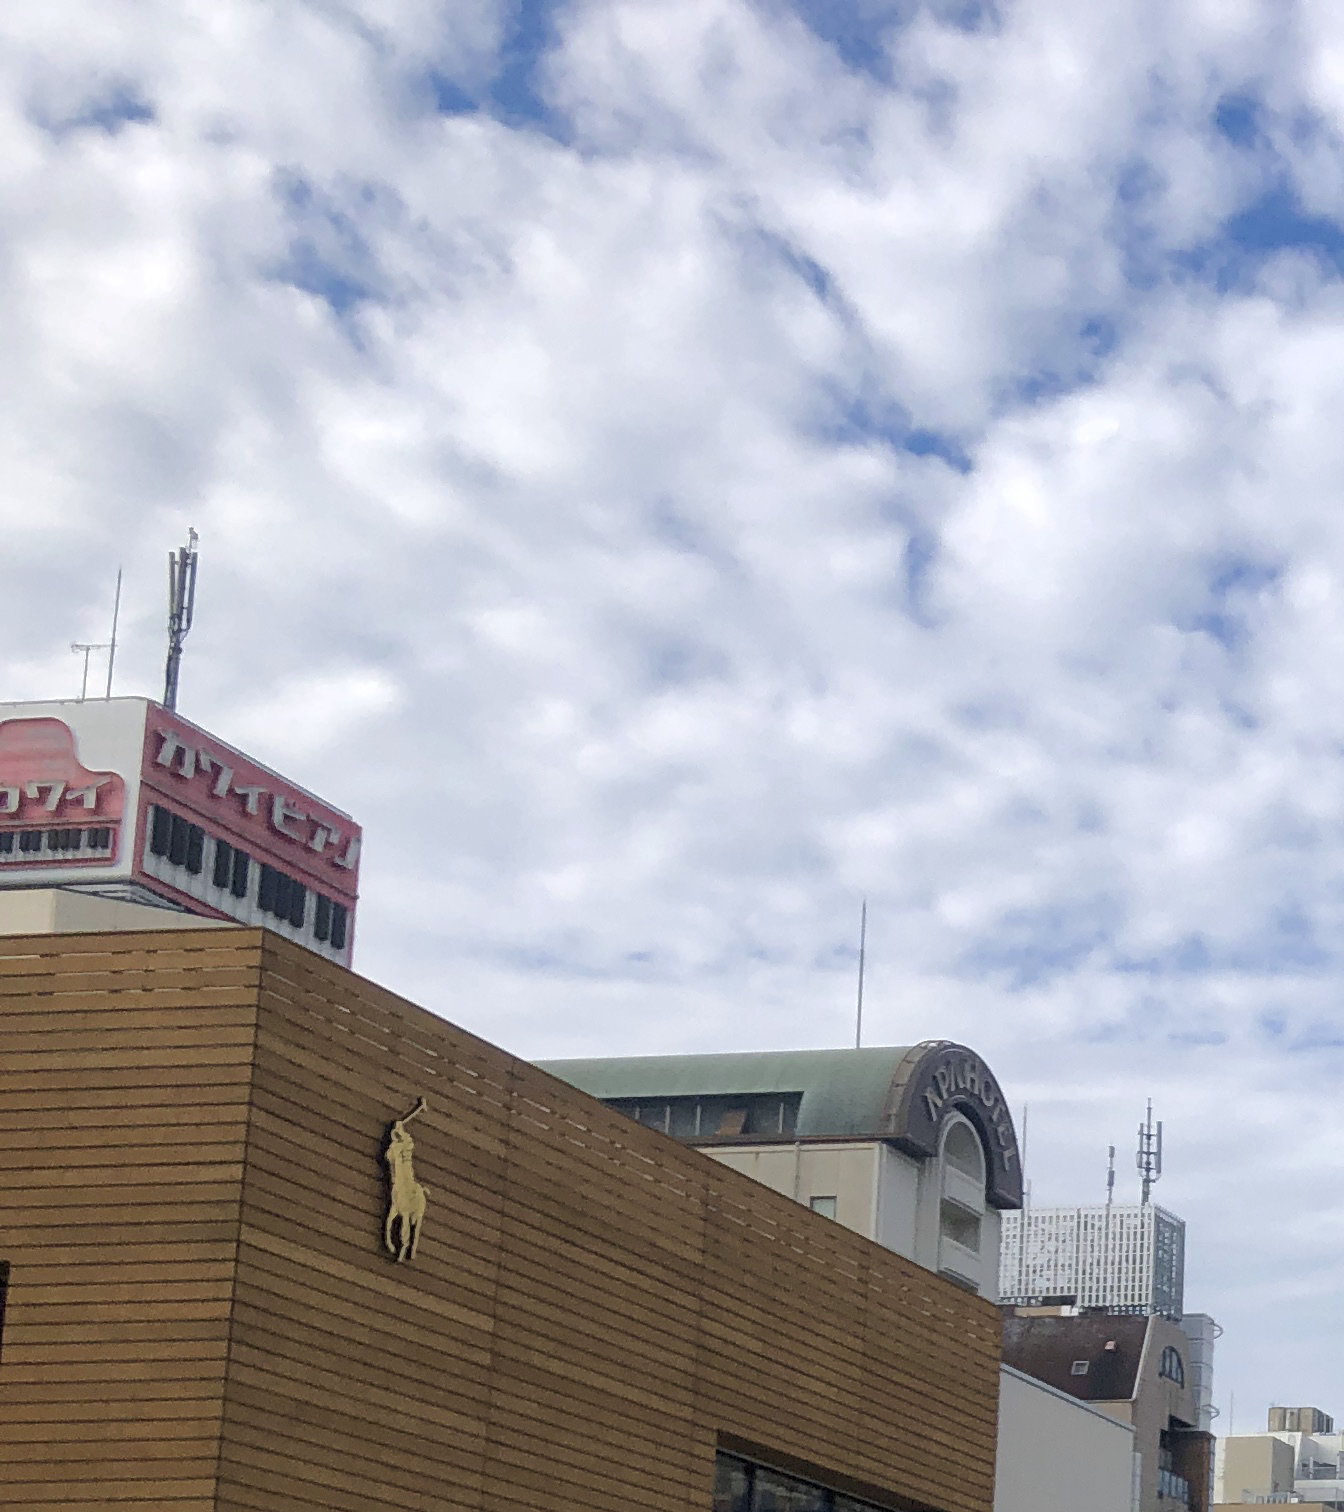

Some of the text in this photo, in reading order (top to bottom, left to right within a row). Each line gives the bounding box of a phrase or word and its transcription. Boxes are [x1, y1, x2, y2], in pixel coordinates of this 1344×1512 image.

[157, 728, 361, 869] カワイピアノ
[964, 1061, 1016, 1171] HOTEL
